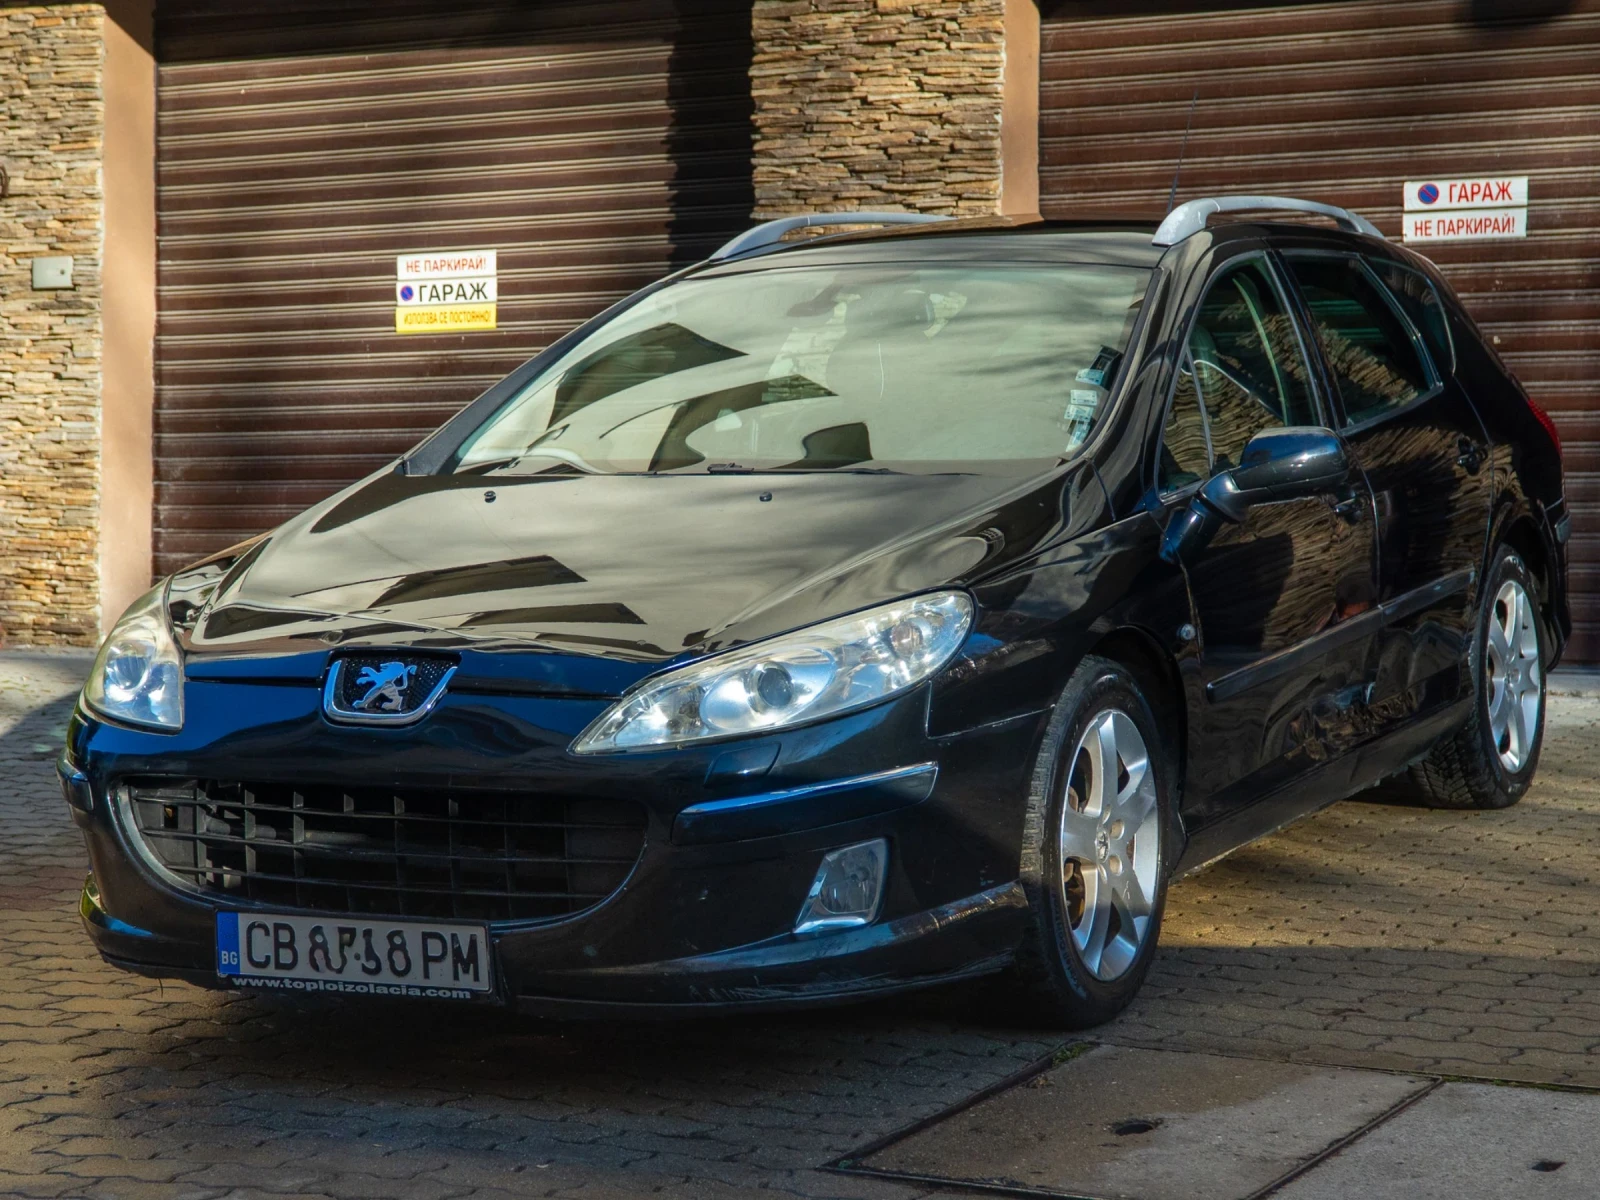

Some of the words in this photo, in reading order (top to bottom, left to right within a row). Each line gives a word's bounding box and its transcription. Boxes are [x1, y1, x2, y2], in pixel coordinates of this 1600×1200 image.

[1449, 181, 1513, 203] ГАРАЖ
[1414, 220, 1432, 237] НЕ
[1437, 213, 1515, 236] ПАРКИРАЙ!
[406, 260, 420, 273] НЕ
[424, 256, 486, 272] ПАРКИРАЙ!
[419, 282, 488, 302] ГАРАЖ
[221, 950, 238, 965] BG
[231, 977, 471, 999] www.toploizolacia.com
